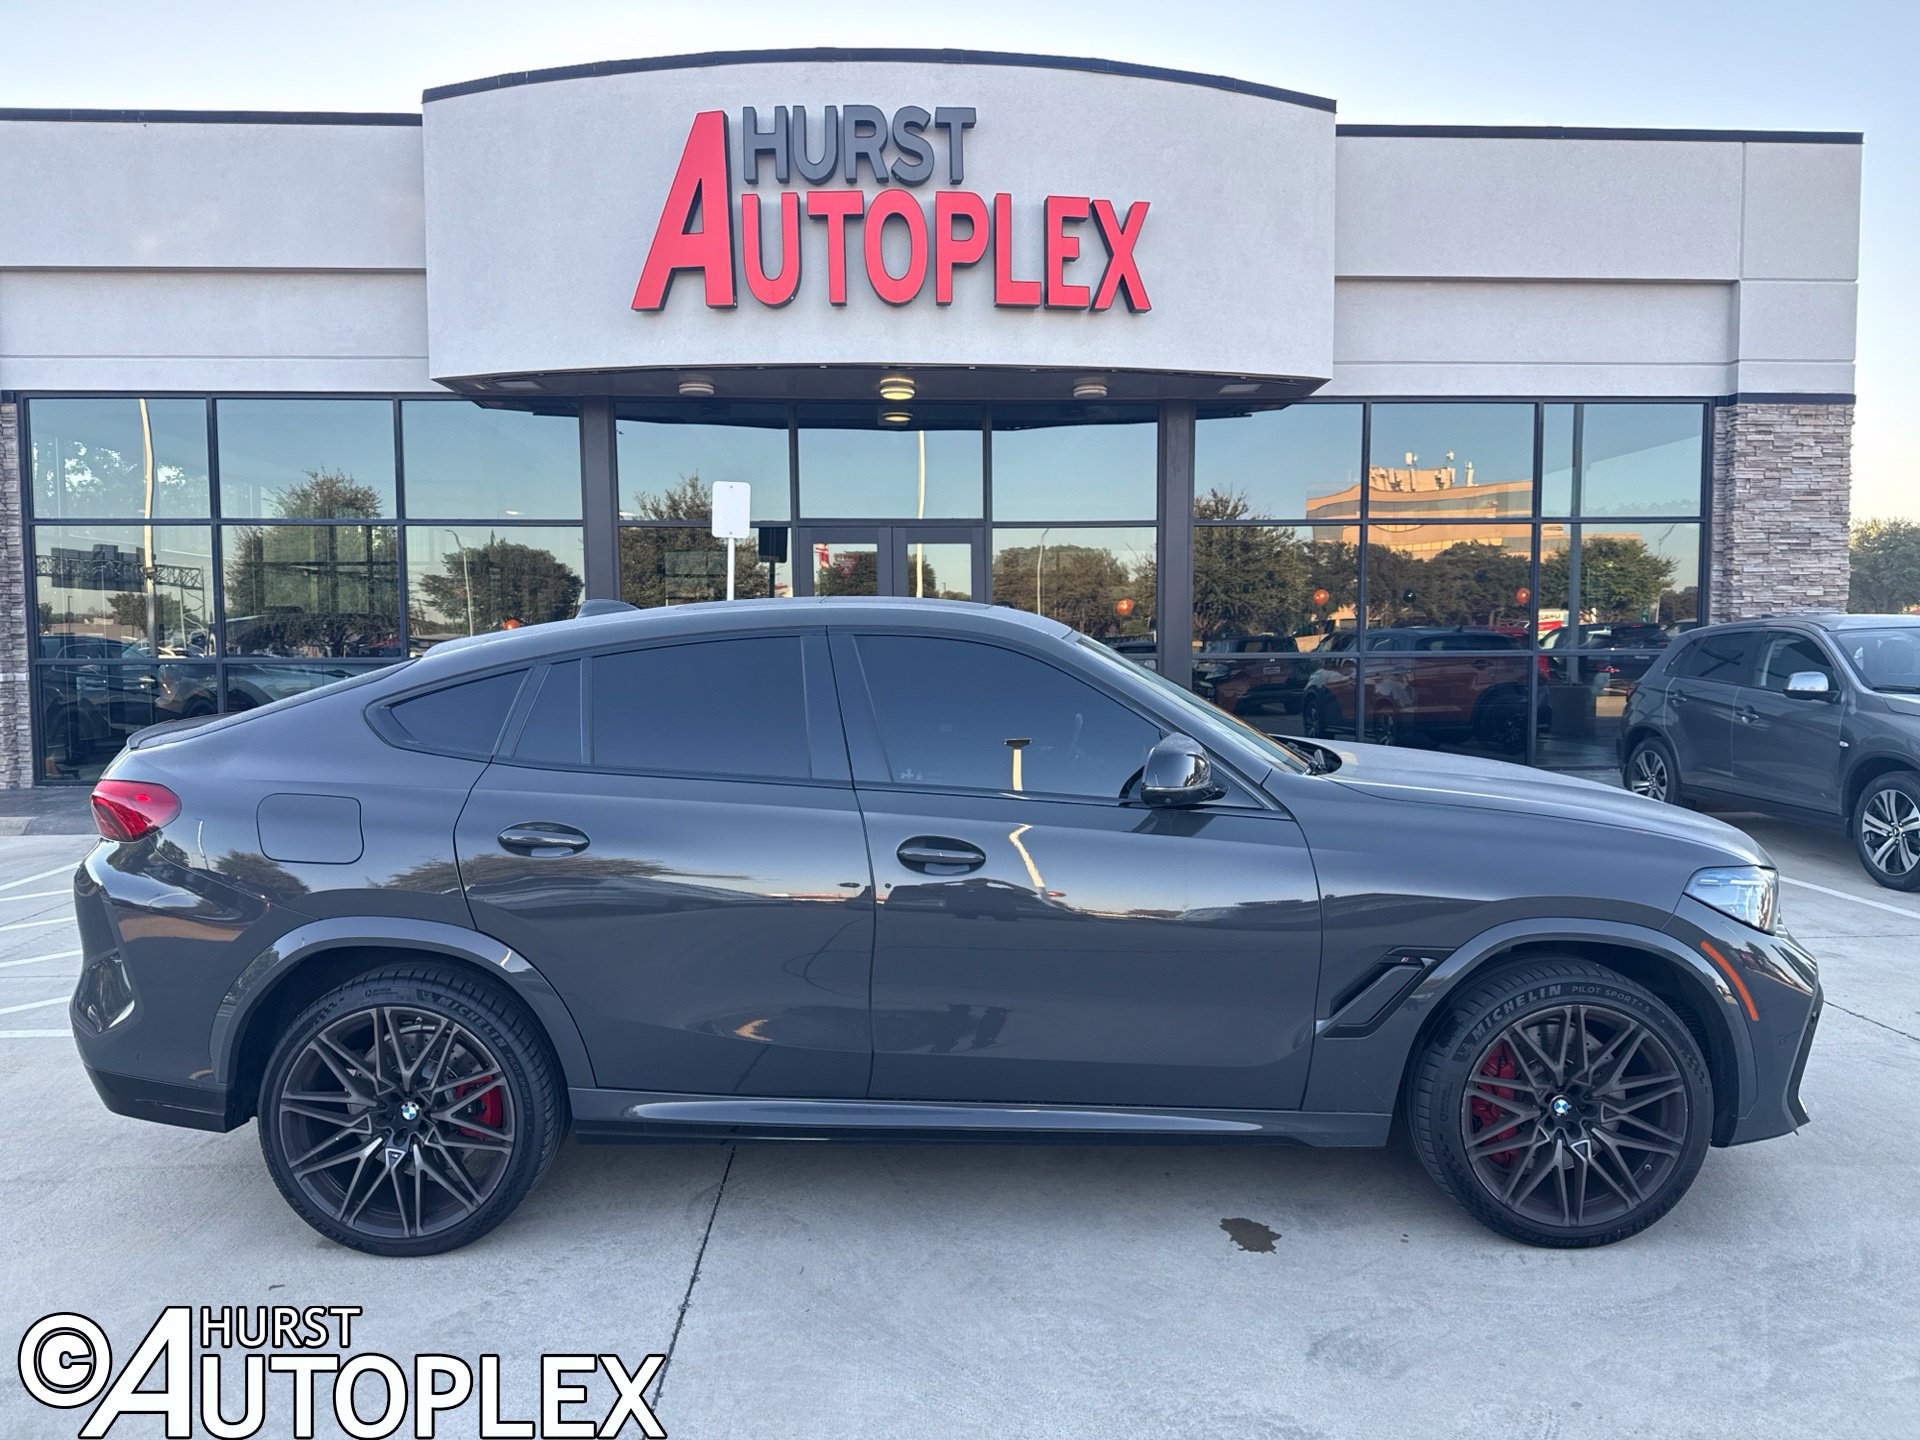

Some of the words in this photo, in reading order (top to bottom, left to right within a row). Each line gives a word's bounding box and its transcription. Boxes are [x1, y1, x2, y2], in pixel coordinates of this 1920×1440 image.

[742, 104, 977, 185] HURST
[631, 110, 1153, 313] AUTOPLEX
[437, 995, 508, 1048] MICHELIN
[1471, 984, 1562, 1040] MICHELIN
[1571, 985, 1602, 994] PILOT
